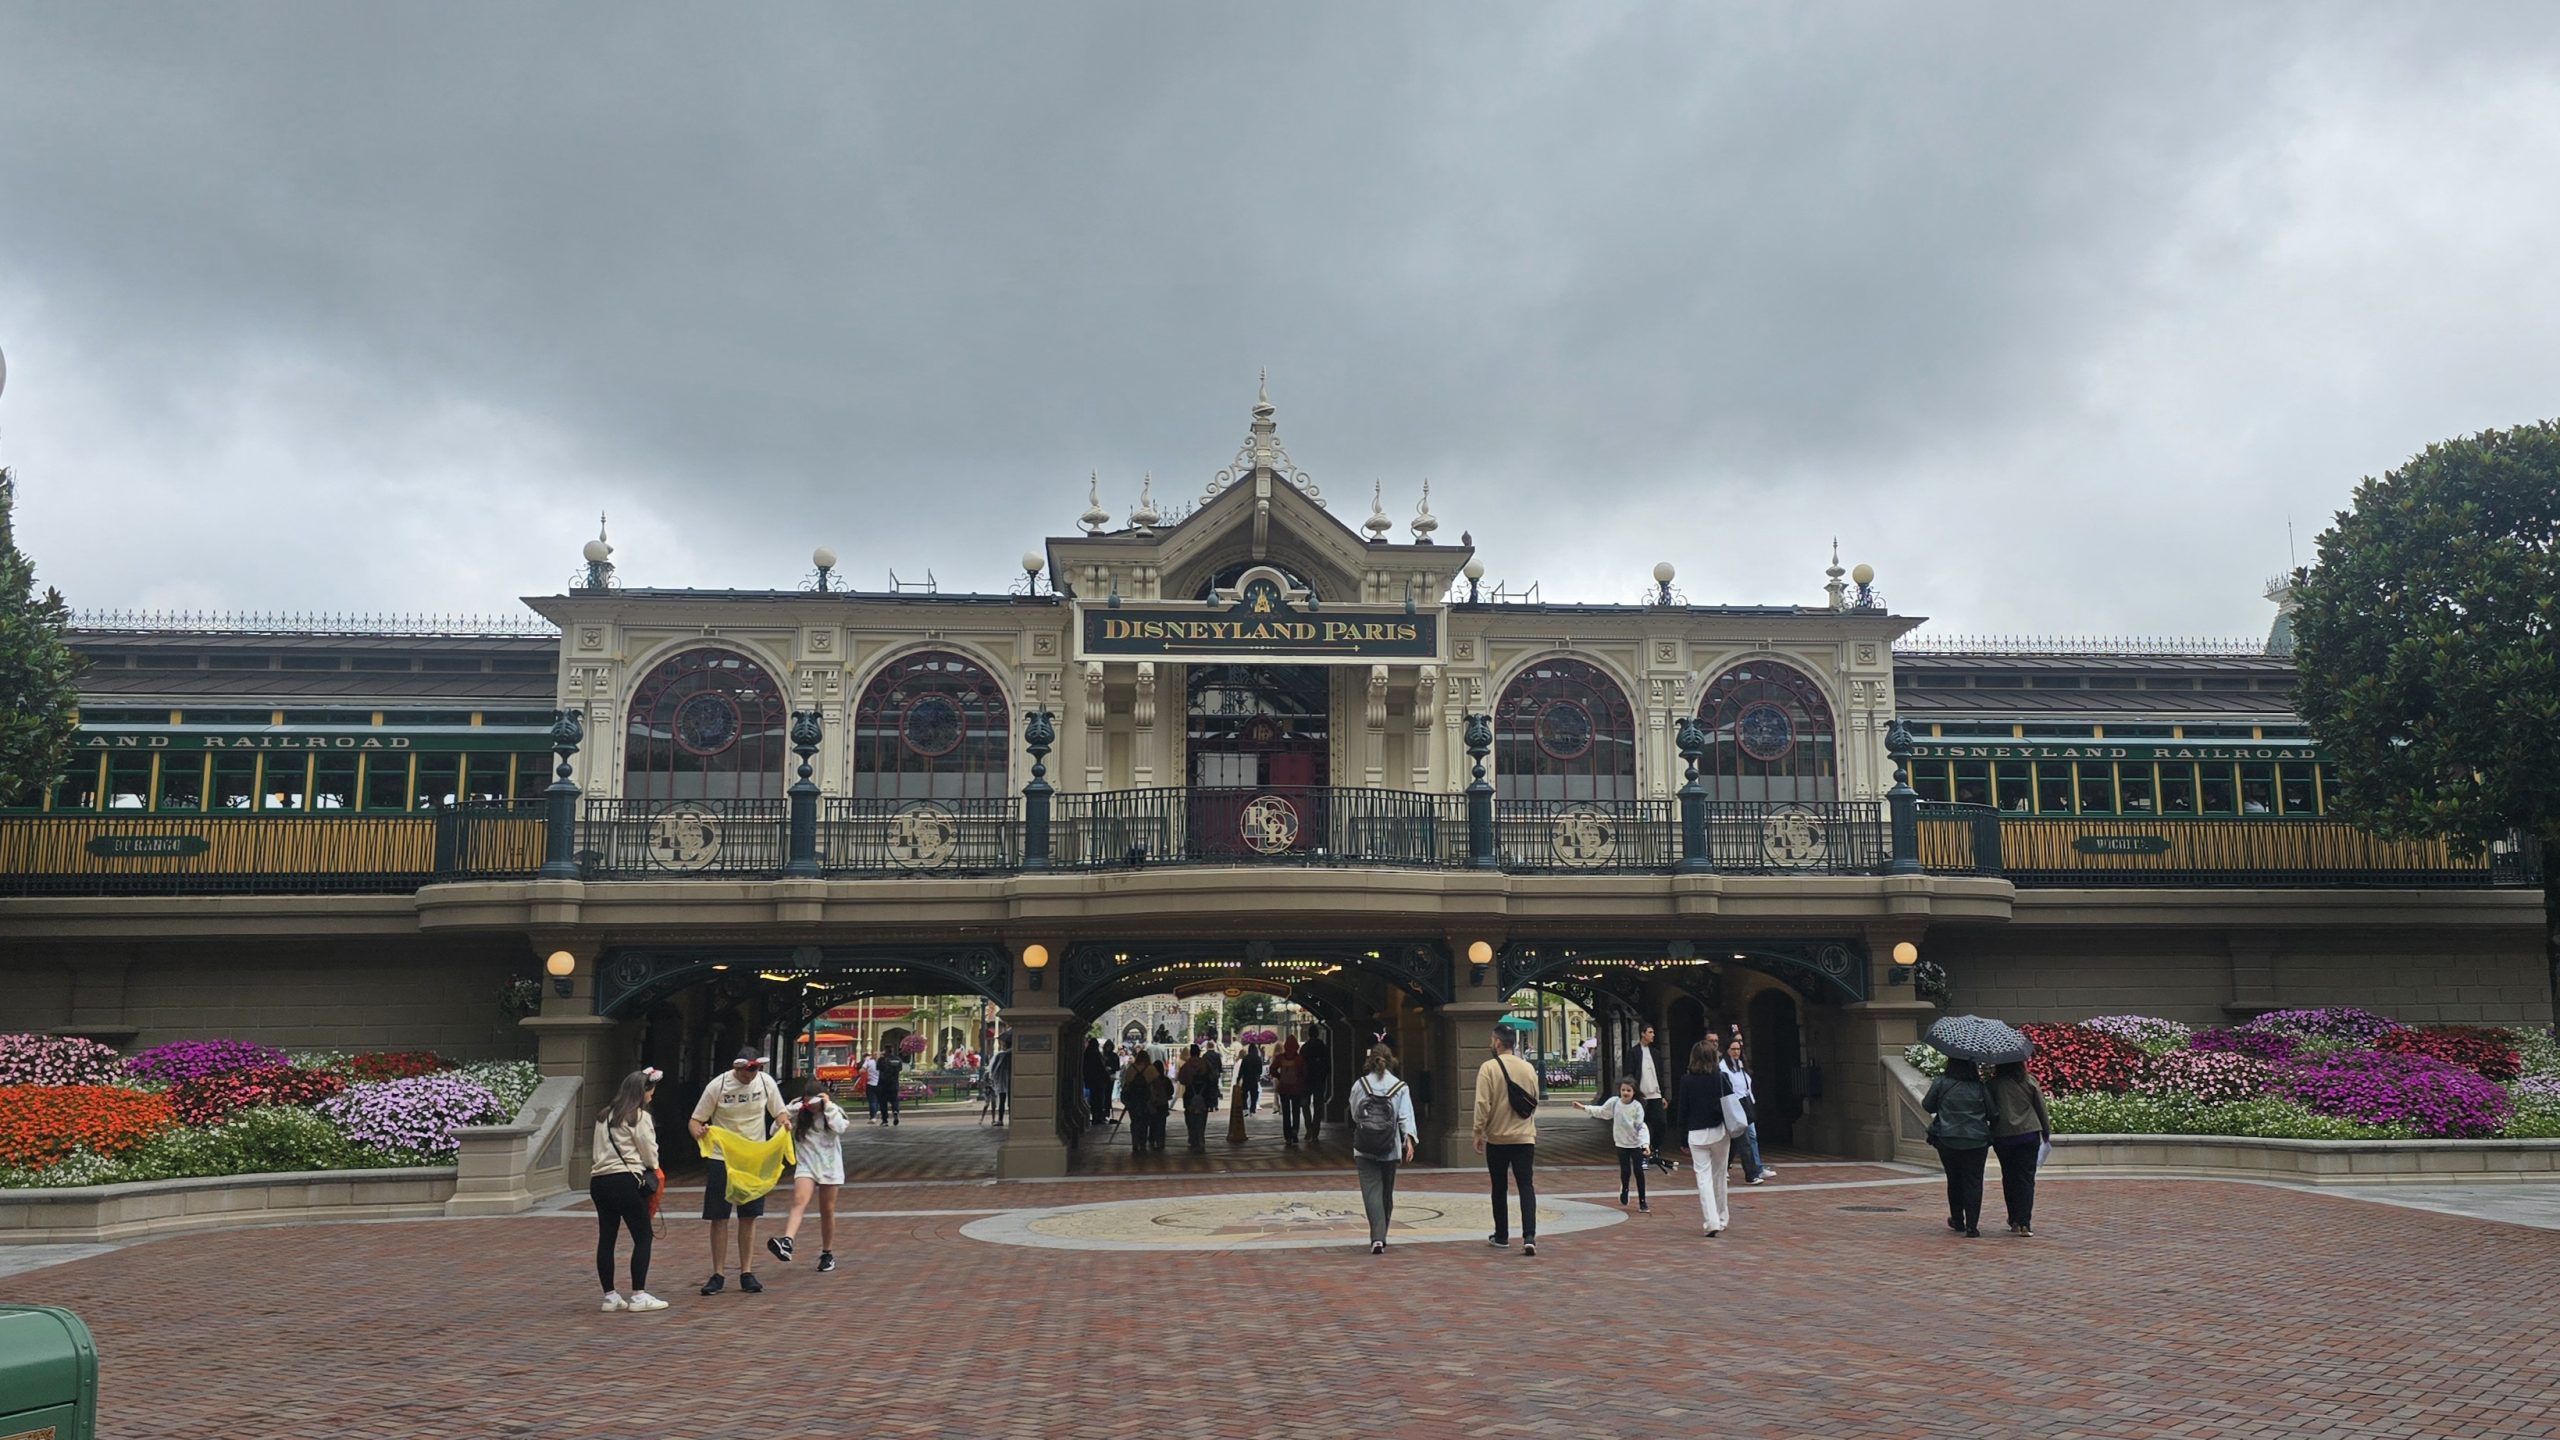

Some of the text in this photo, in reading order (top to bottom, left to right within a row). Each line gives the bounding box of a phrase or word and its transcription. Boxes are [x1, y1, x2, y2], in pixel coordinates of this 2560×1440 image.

[1103, 618, 1417, 642] DISNEYLAND PARIS
[75, 735, 411, 748] AND RAILROAD
[1911, 746, 2316, 759] DISNEYLAND RAILROAD
